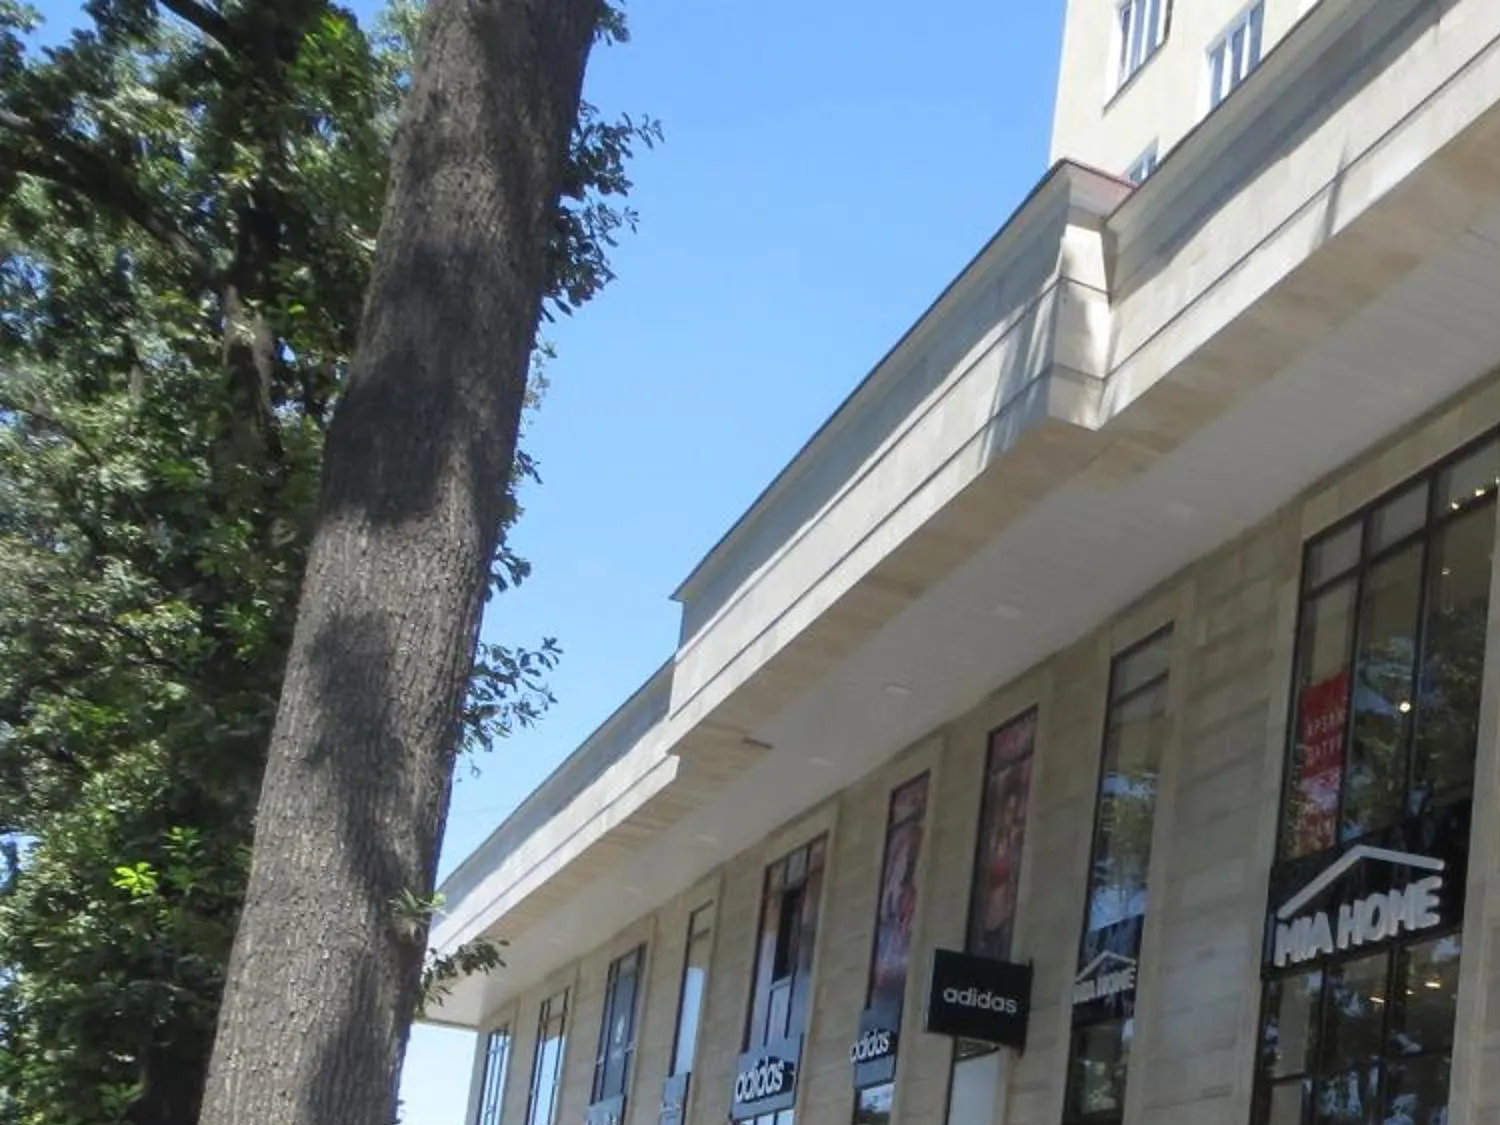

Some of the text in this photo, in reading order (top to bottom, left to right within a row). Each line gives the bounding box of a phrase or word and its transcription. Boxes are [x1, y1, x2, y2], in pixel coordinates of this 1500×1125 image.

[1273, 874, 1443, 967] MIA HOME
[943, 986, 1017, 1013] adidas
